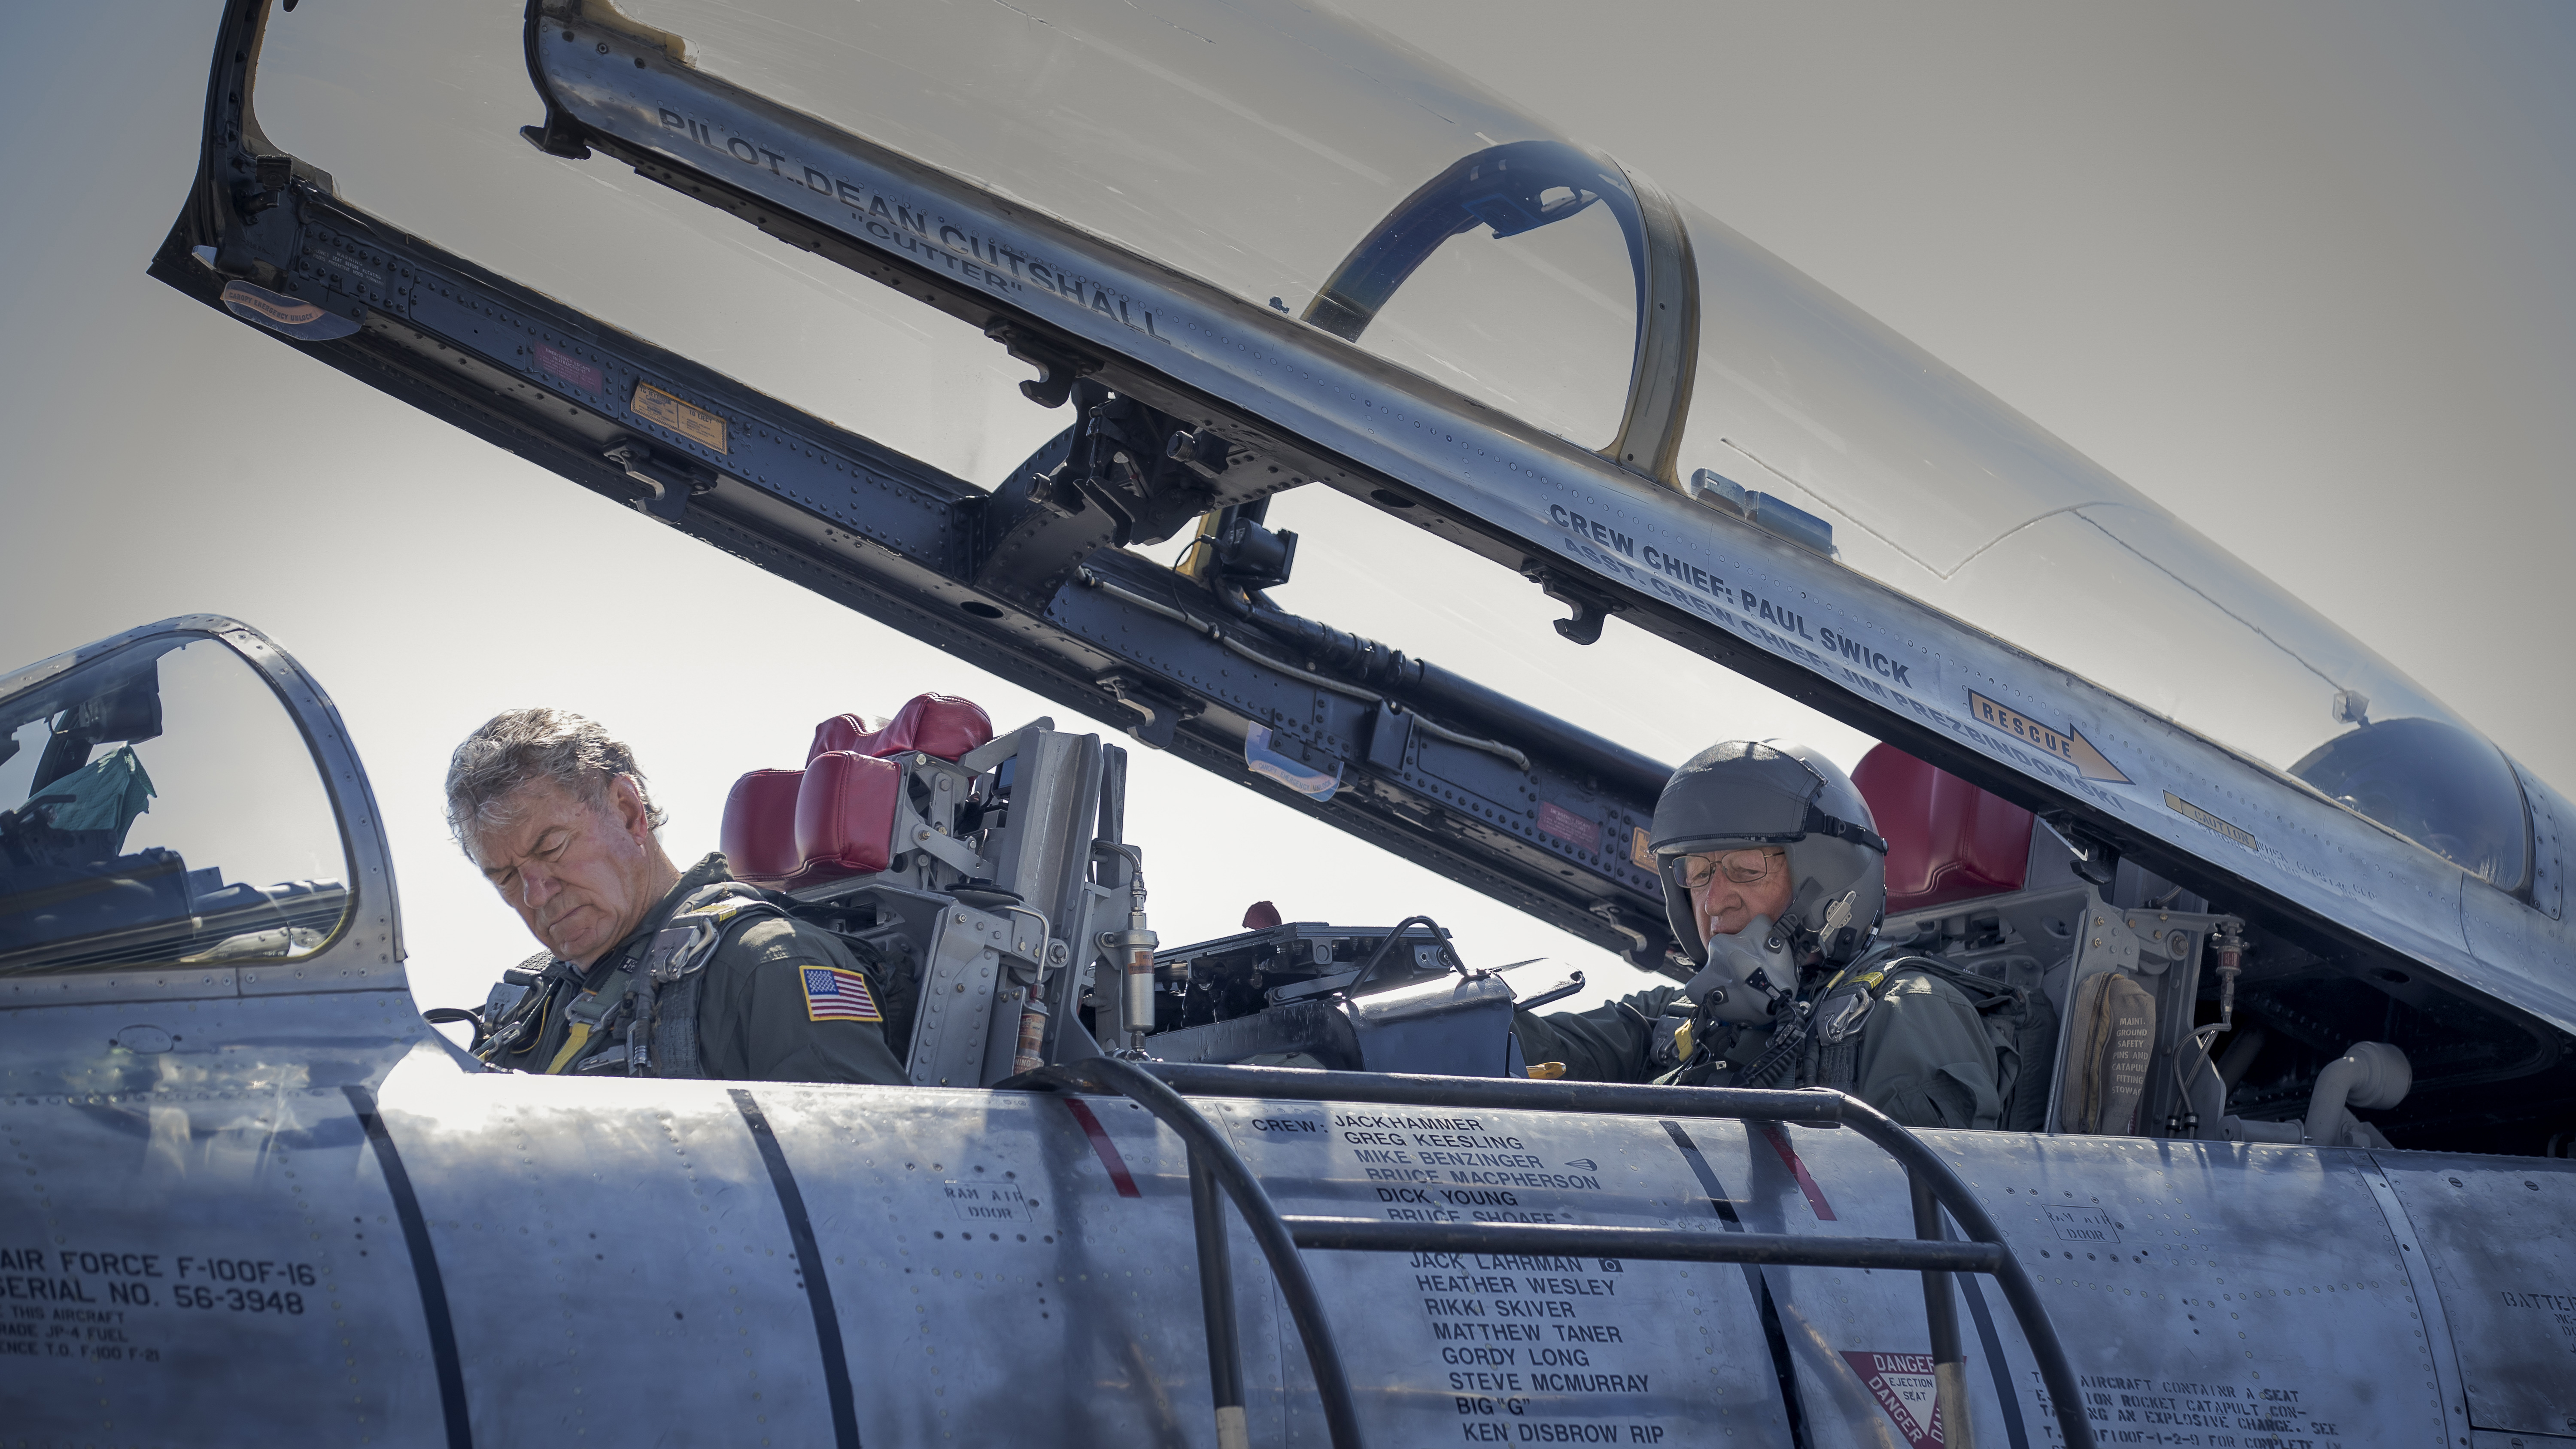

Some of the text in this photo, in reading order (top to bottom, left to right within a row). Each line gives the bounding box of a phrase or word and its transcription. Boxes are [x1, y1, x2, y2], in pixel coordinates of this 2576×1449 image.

[337, 251, 363, 266] WARNING
[852, 213, 1022, 294] "CUTTER"
[313, 253, 325, 262] PILOTS
[328, 260, 350, 272] PROTECTIVE
[366, 275, 384, 286] FORWARD
[345, 261, 359, 270] BEFORE
[362, 268, 381, 280] ROTATING
[939, 225, 1171, 345] CUTSHALL
[229, 292, 313, 321] CANOPY EMERGENCY UNLOCK
[546, 348, 572, 364] EMERGENCY
[574, 361, 590, 372] ESCAPE
[553, 356, 585, 373] INSTRUCTIONS
[649, 391, 671, 405] JETTISON
[698, 413, 711, 424] EJECT
[1550, 504, 1913, 689] CREW CHIEF: PAUL SWICK
[1564, 537, 2126, 812] ASST. CREW CHIEF: JIM PREZBINDOWSKI
[1981, 701, 2072, 759] RESCUE
[1258, 763, 1331, 791] CANOPY EMERGENCY UNLOCK
[2194, 810, 2250, 844] CAUTION
[2113, 1051, 2128, 1060] PINS
[2116, 1075, 2143, 1084] FITTING
[1334, 1115, 1484, 1131] JACKHAMMER
[1344, 1131, 1524, 1150] GREG KEESLING
[1353, 1149, 1545, 1169] MIKE BENZINGER
[1365, 1168, 1601, 1190] BRUCE MACPHERSON
[944, 1188, 979, 1200] RAM
[1376, 1188, 1518, 1206] DICK YOUNG
[968, 1206, 1012, 1219] DOOR
[2066, 1229, 2106, 1240] DOOR
[0, 1248, 316, 1286] AIR FORCE F-100F-16
[1410, 1252, 1583, 1273] JACK LAHRMAN
[1416, 1276, 1615, 1296] HEATHER WESLEY
[108, 1281, 159, 1307] NO.
[173, 1284, 304, 1315] 56-3948
[1424, 1298, 1576, 1318] RIKKI SKIVER
[10, 1305, 124, 1324] THIS AIRCRAFT
[46, 1324, 80, 1339] JP-4
[86, 1326, 128, 1343] FUEL
[1432, 1323, 1624, 1343] MATTHEW TANER
[80, 1344, 122, 1360] F-100
[1442, 1347, 1589, 1367] GORDY LONG
[1449, 1372, 1649, 1392] STEVE MCMURRAY
[1889, 1377, 1934, 1388] EJECTION
[2081, 1375, 2151, 1391] AIRCRAFT
[2246, 1387, 2255, 1400] A
[2263, 1388, 2298, 1403] SEAT
[1903, 1391, 1926, 1401] SEAT
[1455, 1397, 1495, 1416] BIG
[1868, 1376, 1923, 1443] DANGER
[2120, 1394, 2175, 1411] ROCKET
[2186, 1399, 2259, 1416] CATAPULT
[2269, 1405, 2306, 1419] CON-
[2117, 1409, 2137, 1422] AN
[2145, 1410, 2230, 1428] EXPLOSIVE
[2238, 1417, 2301, 1433] CHARGE.
[2311, 1422, 2339, 1435] SEE
[1462, 1422, 1664, 1444] KEN DISBROW RIP
[2208, 1435, 2236, 1448] FOR
